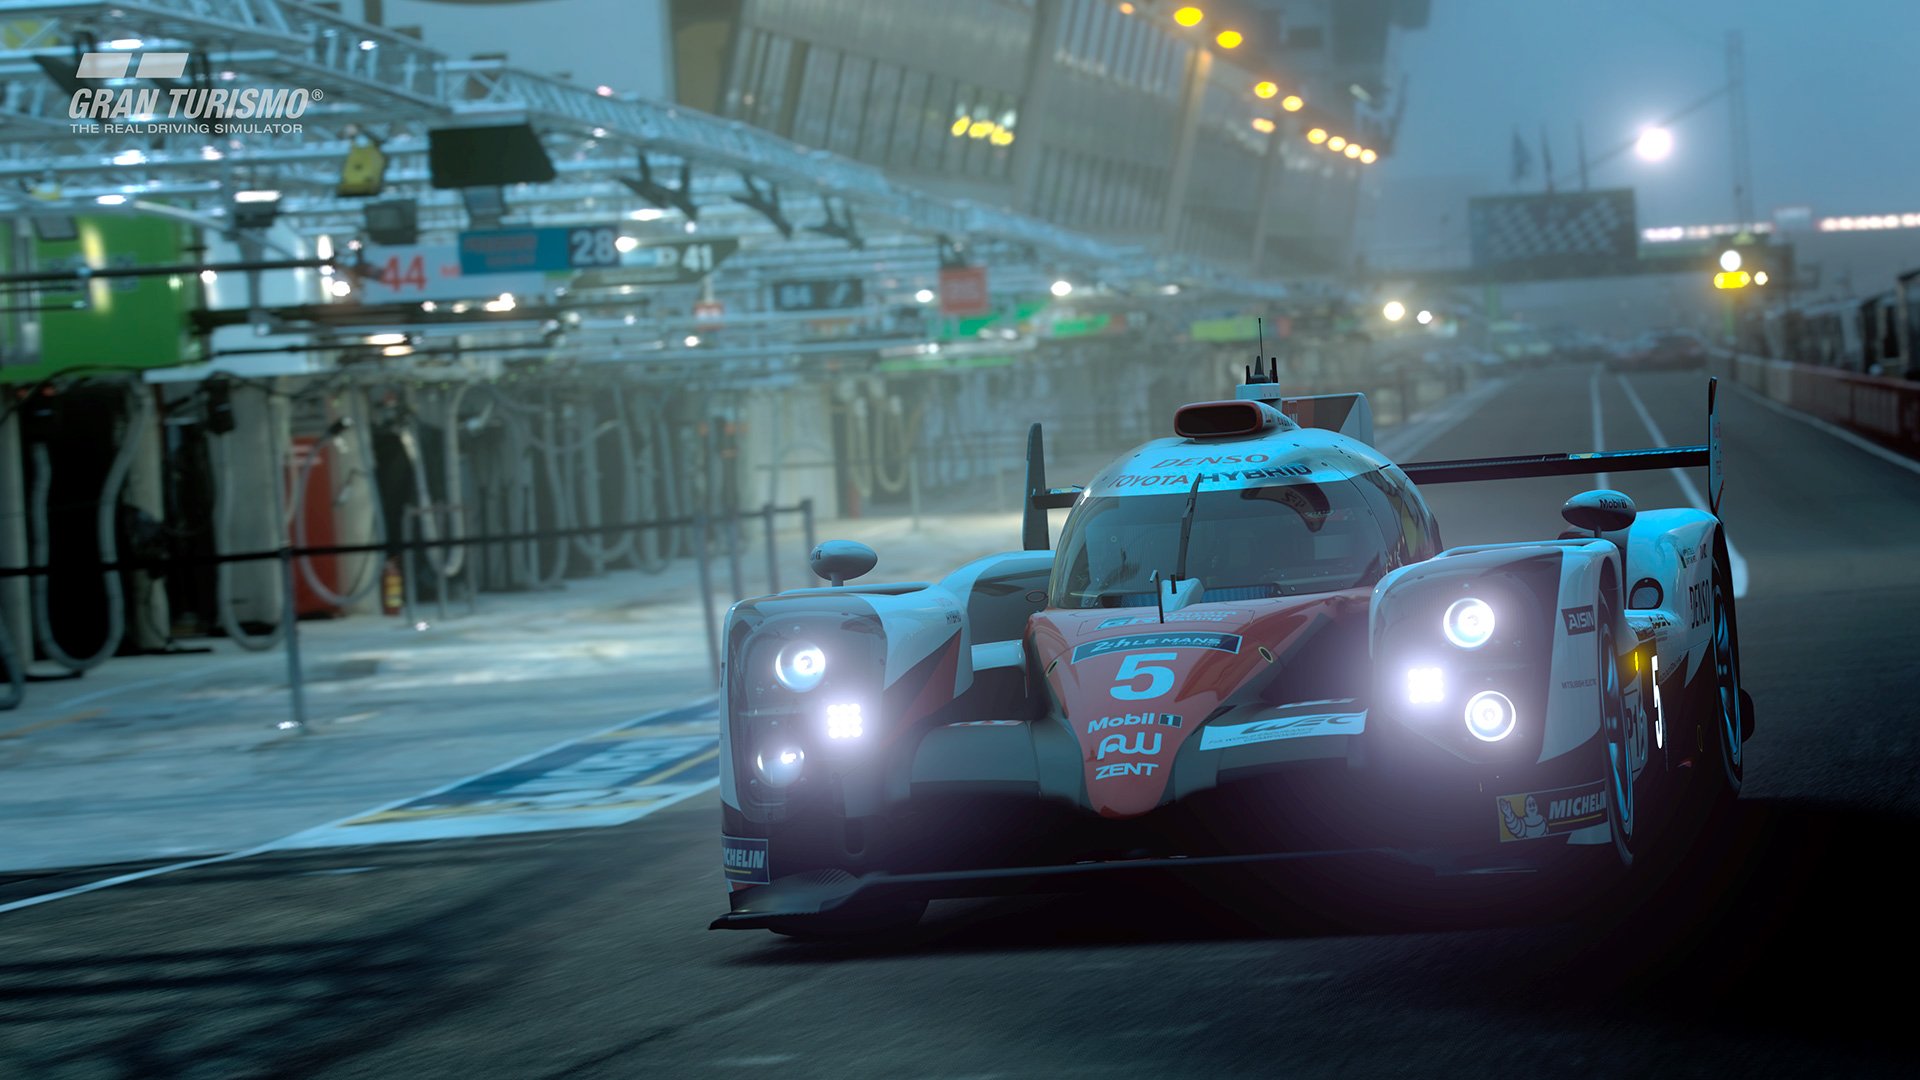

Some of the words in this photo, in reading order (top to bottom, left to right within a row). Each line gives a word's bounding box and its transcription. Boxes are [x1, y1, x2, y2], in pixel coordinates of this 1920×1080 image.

[570, 229, 617, 265] 28
[681, 244, 714, 273] 41
[379, 254, 427, 292] 44
[1151, 453, 1270, 469] DENSO
[1107, 473, 1189, 489] TOYOTA
[1200, 463, 1314, 484] HYBRID
[1132, 638, 1159, 646] LE
[1161, 637, 1222, 645] MANS
[1109, 652, 1178, 700] 5
[1651, 655, 1663, 749] 5
[1087, 712, 1156, 734] Mobil
[1095, 762, 1160, 781] ZENT
